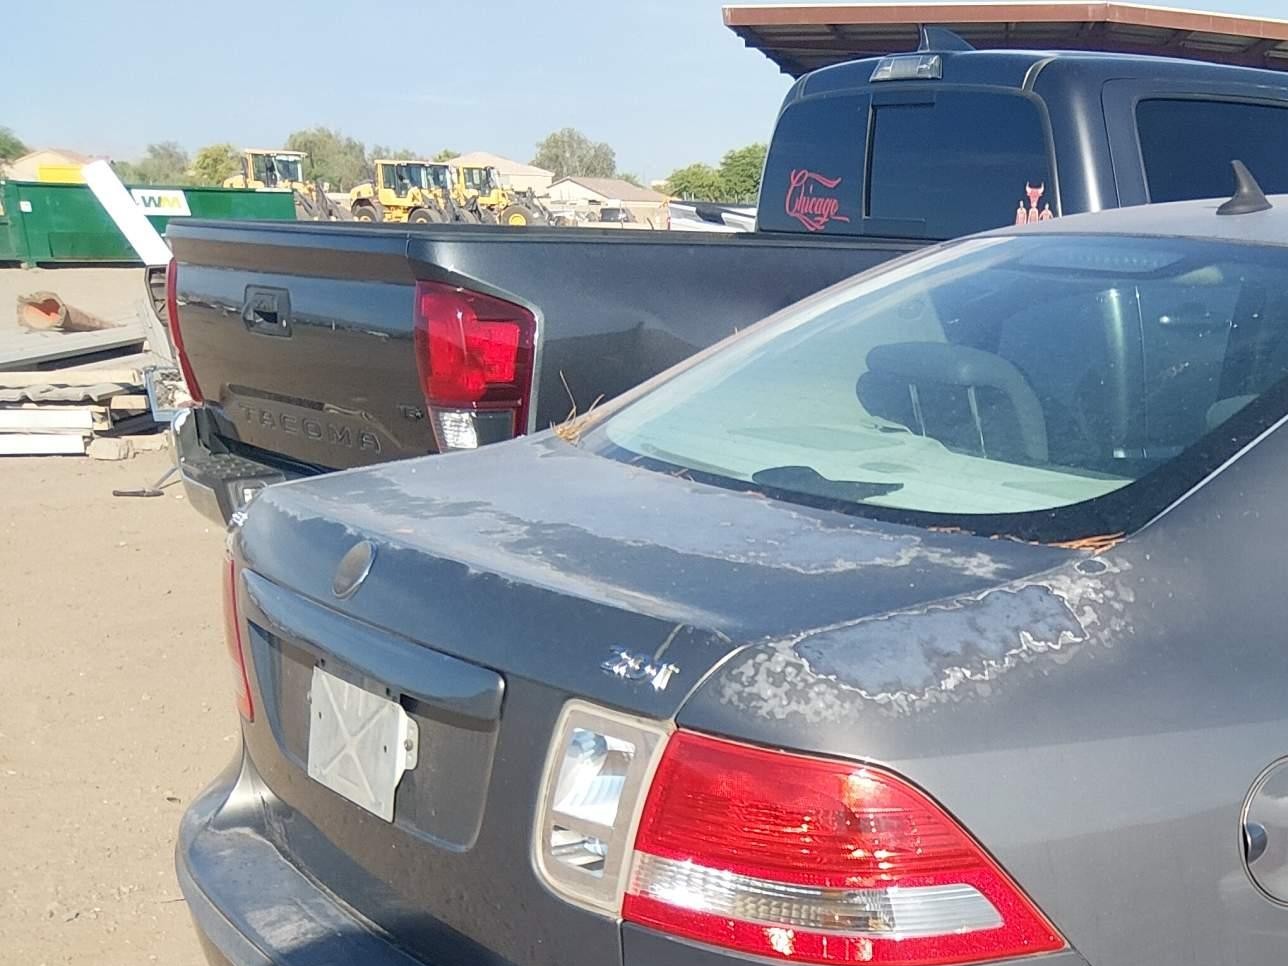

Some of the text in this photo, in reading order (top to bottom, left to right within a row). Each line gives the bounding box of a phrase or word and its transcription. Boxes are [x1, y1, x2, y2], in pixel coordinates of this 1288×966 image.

[141, 195, 182, 208] WM
[785, 168, 849, 231] Chicago
[239, 402, 382, 455] TACOMA
